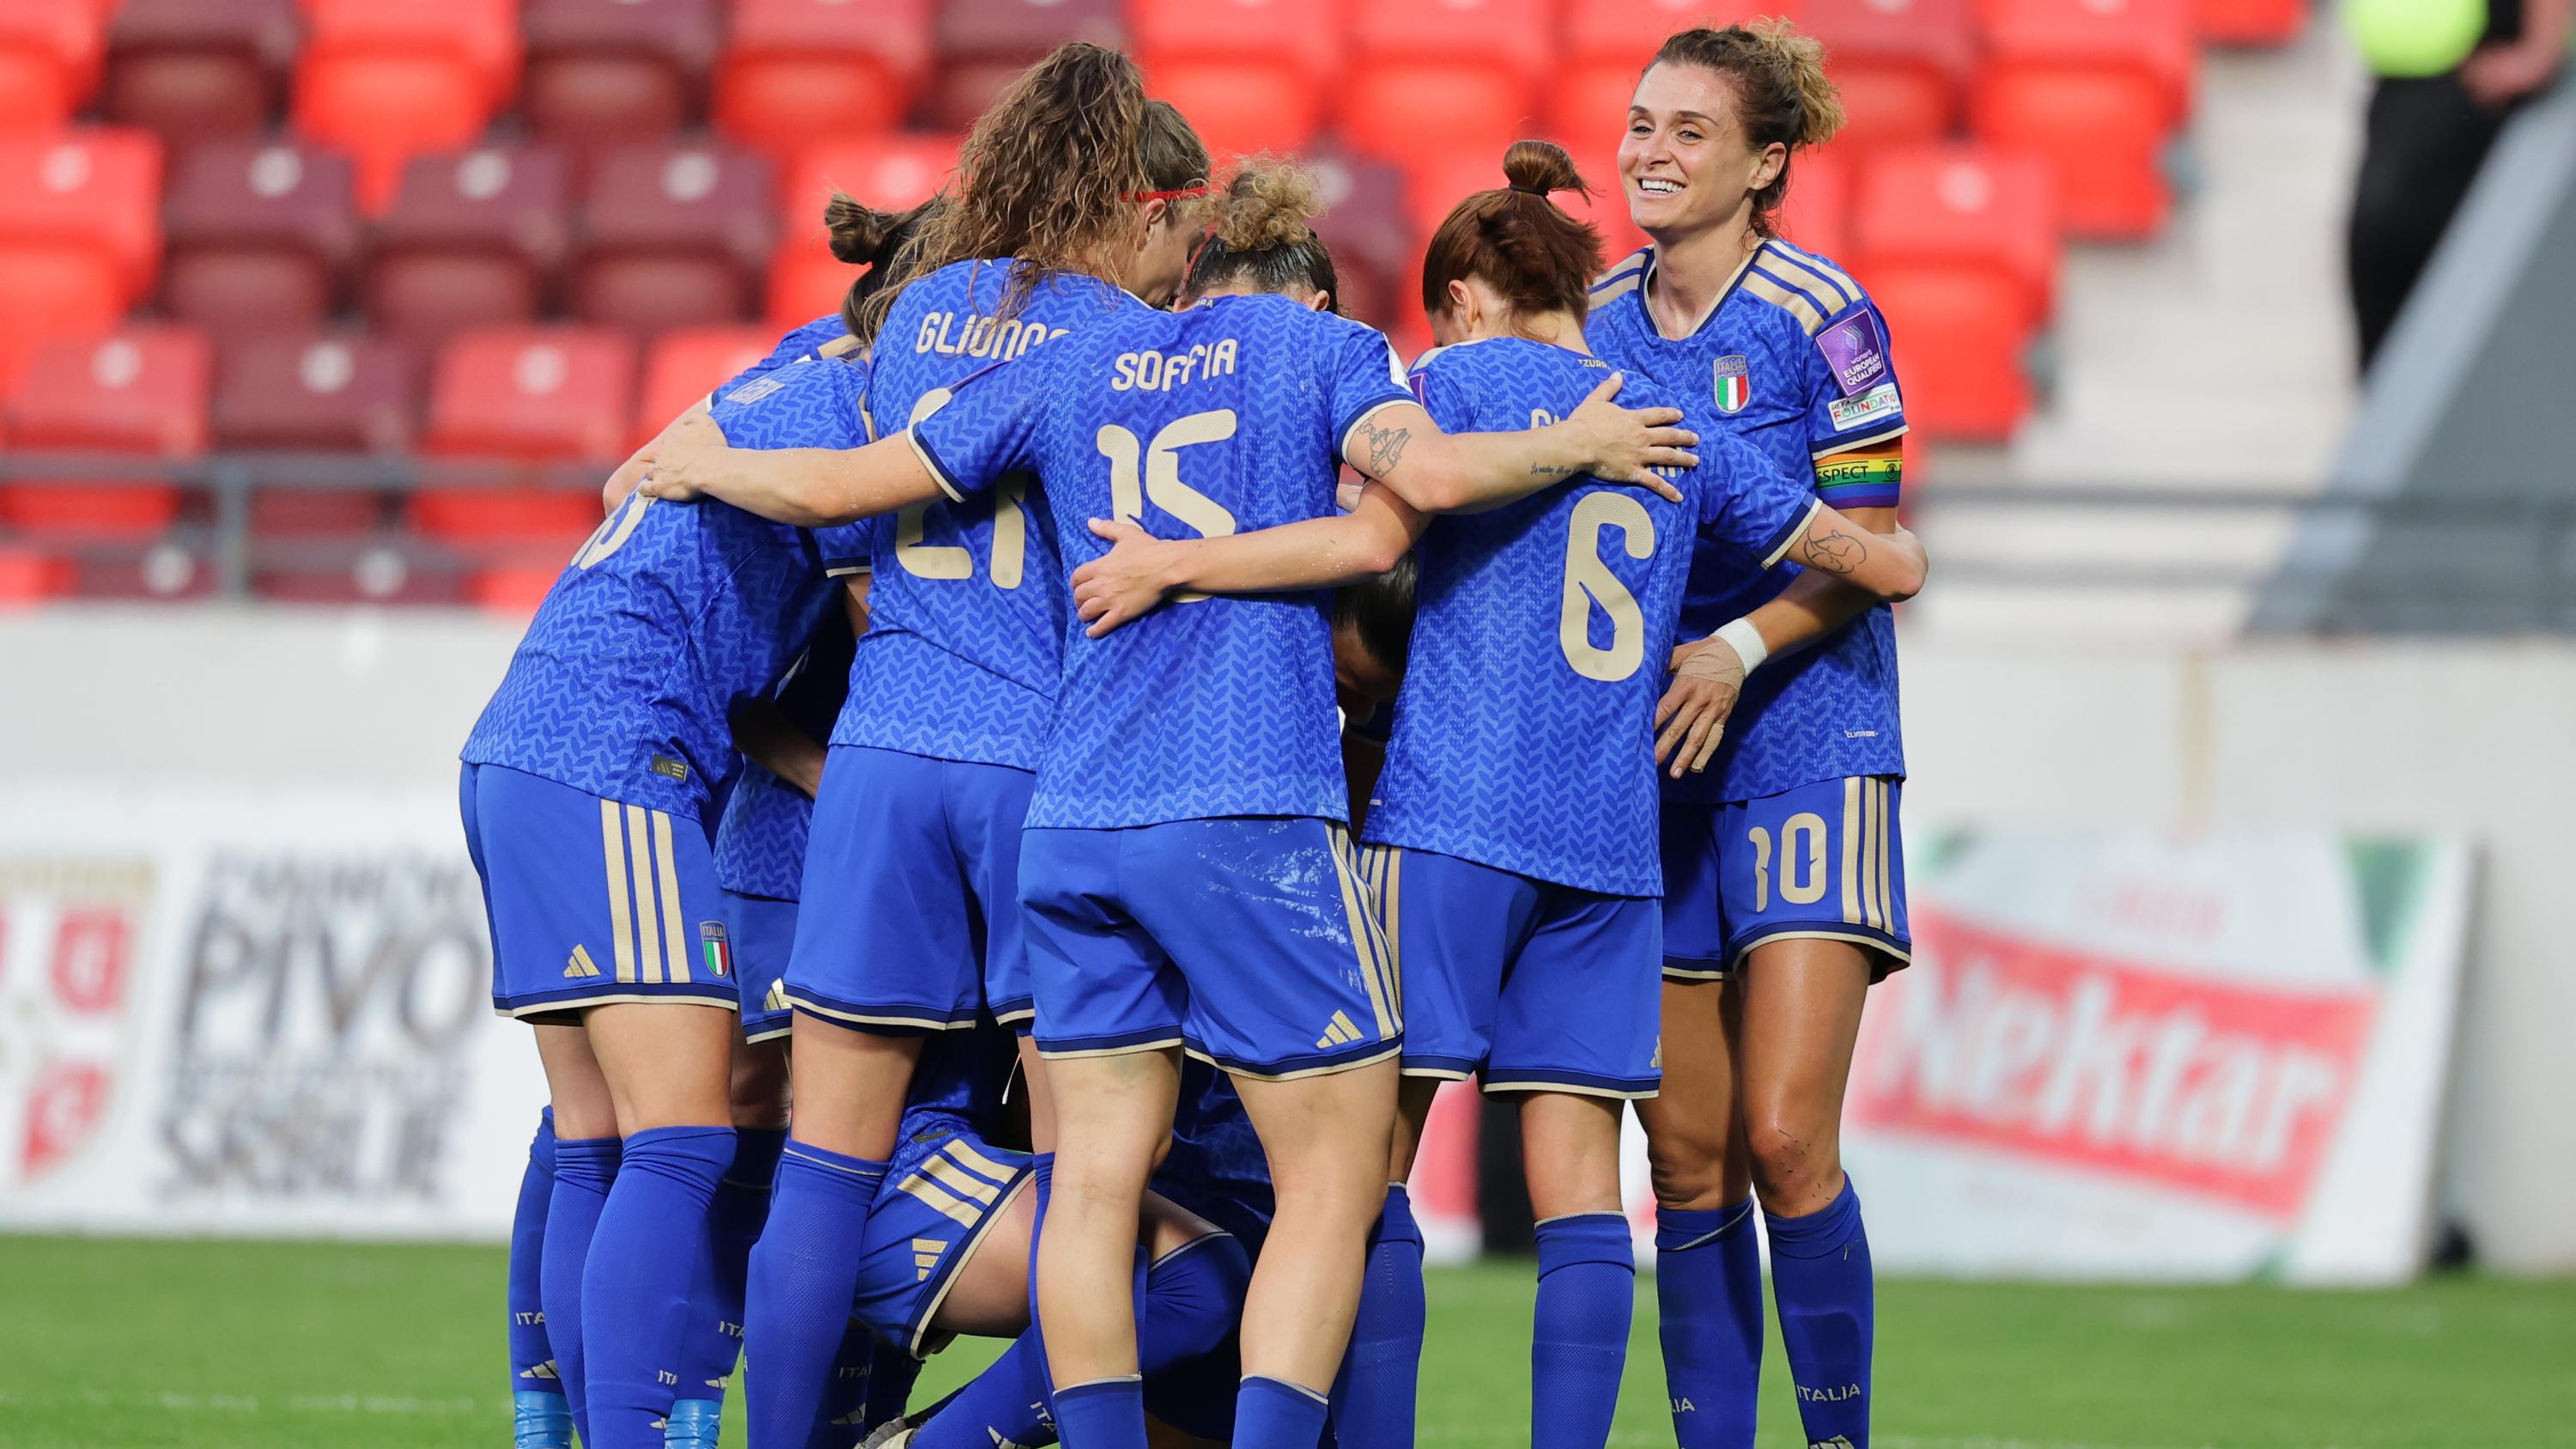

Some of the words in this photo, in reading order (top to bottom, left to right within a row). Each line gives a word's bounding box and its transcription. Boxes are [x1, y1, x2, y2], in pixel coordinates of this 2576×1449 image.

[1111, 338, 1237, 392] SOFFIA
[1844, 352, 1880, 378] EUROPEAN
[1847, 361, 1882, 386] QUALIFIERS
[1833, 393, 1898, 420] FOUNDATIO
[1097, 409, 1237, 602] 15
[1559, 490, 1656, 682] 6
[1748, 812, 1827, 913] 10
[702, 925, 724, 937] ITALIA
[179, 911, 483, 1050] PIVO
[1879, 952, 2334, 1172] Nektar
[1796, 1383, 1861, 1401] ITALIA
